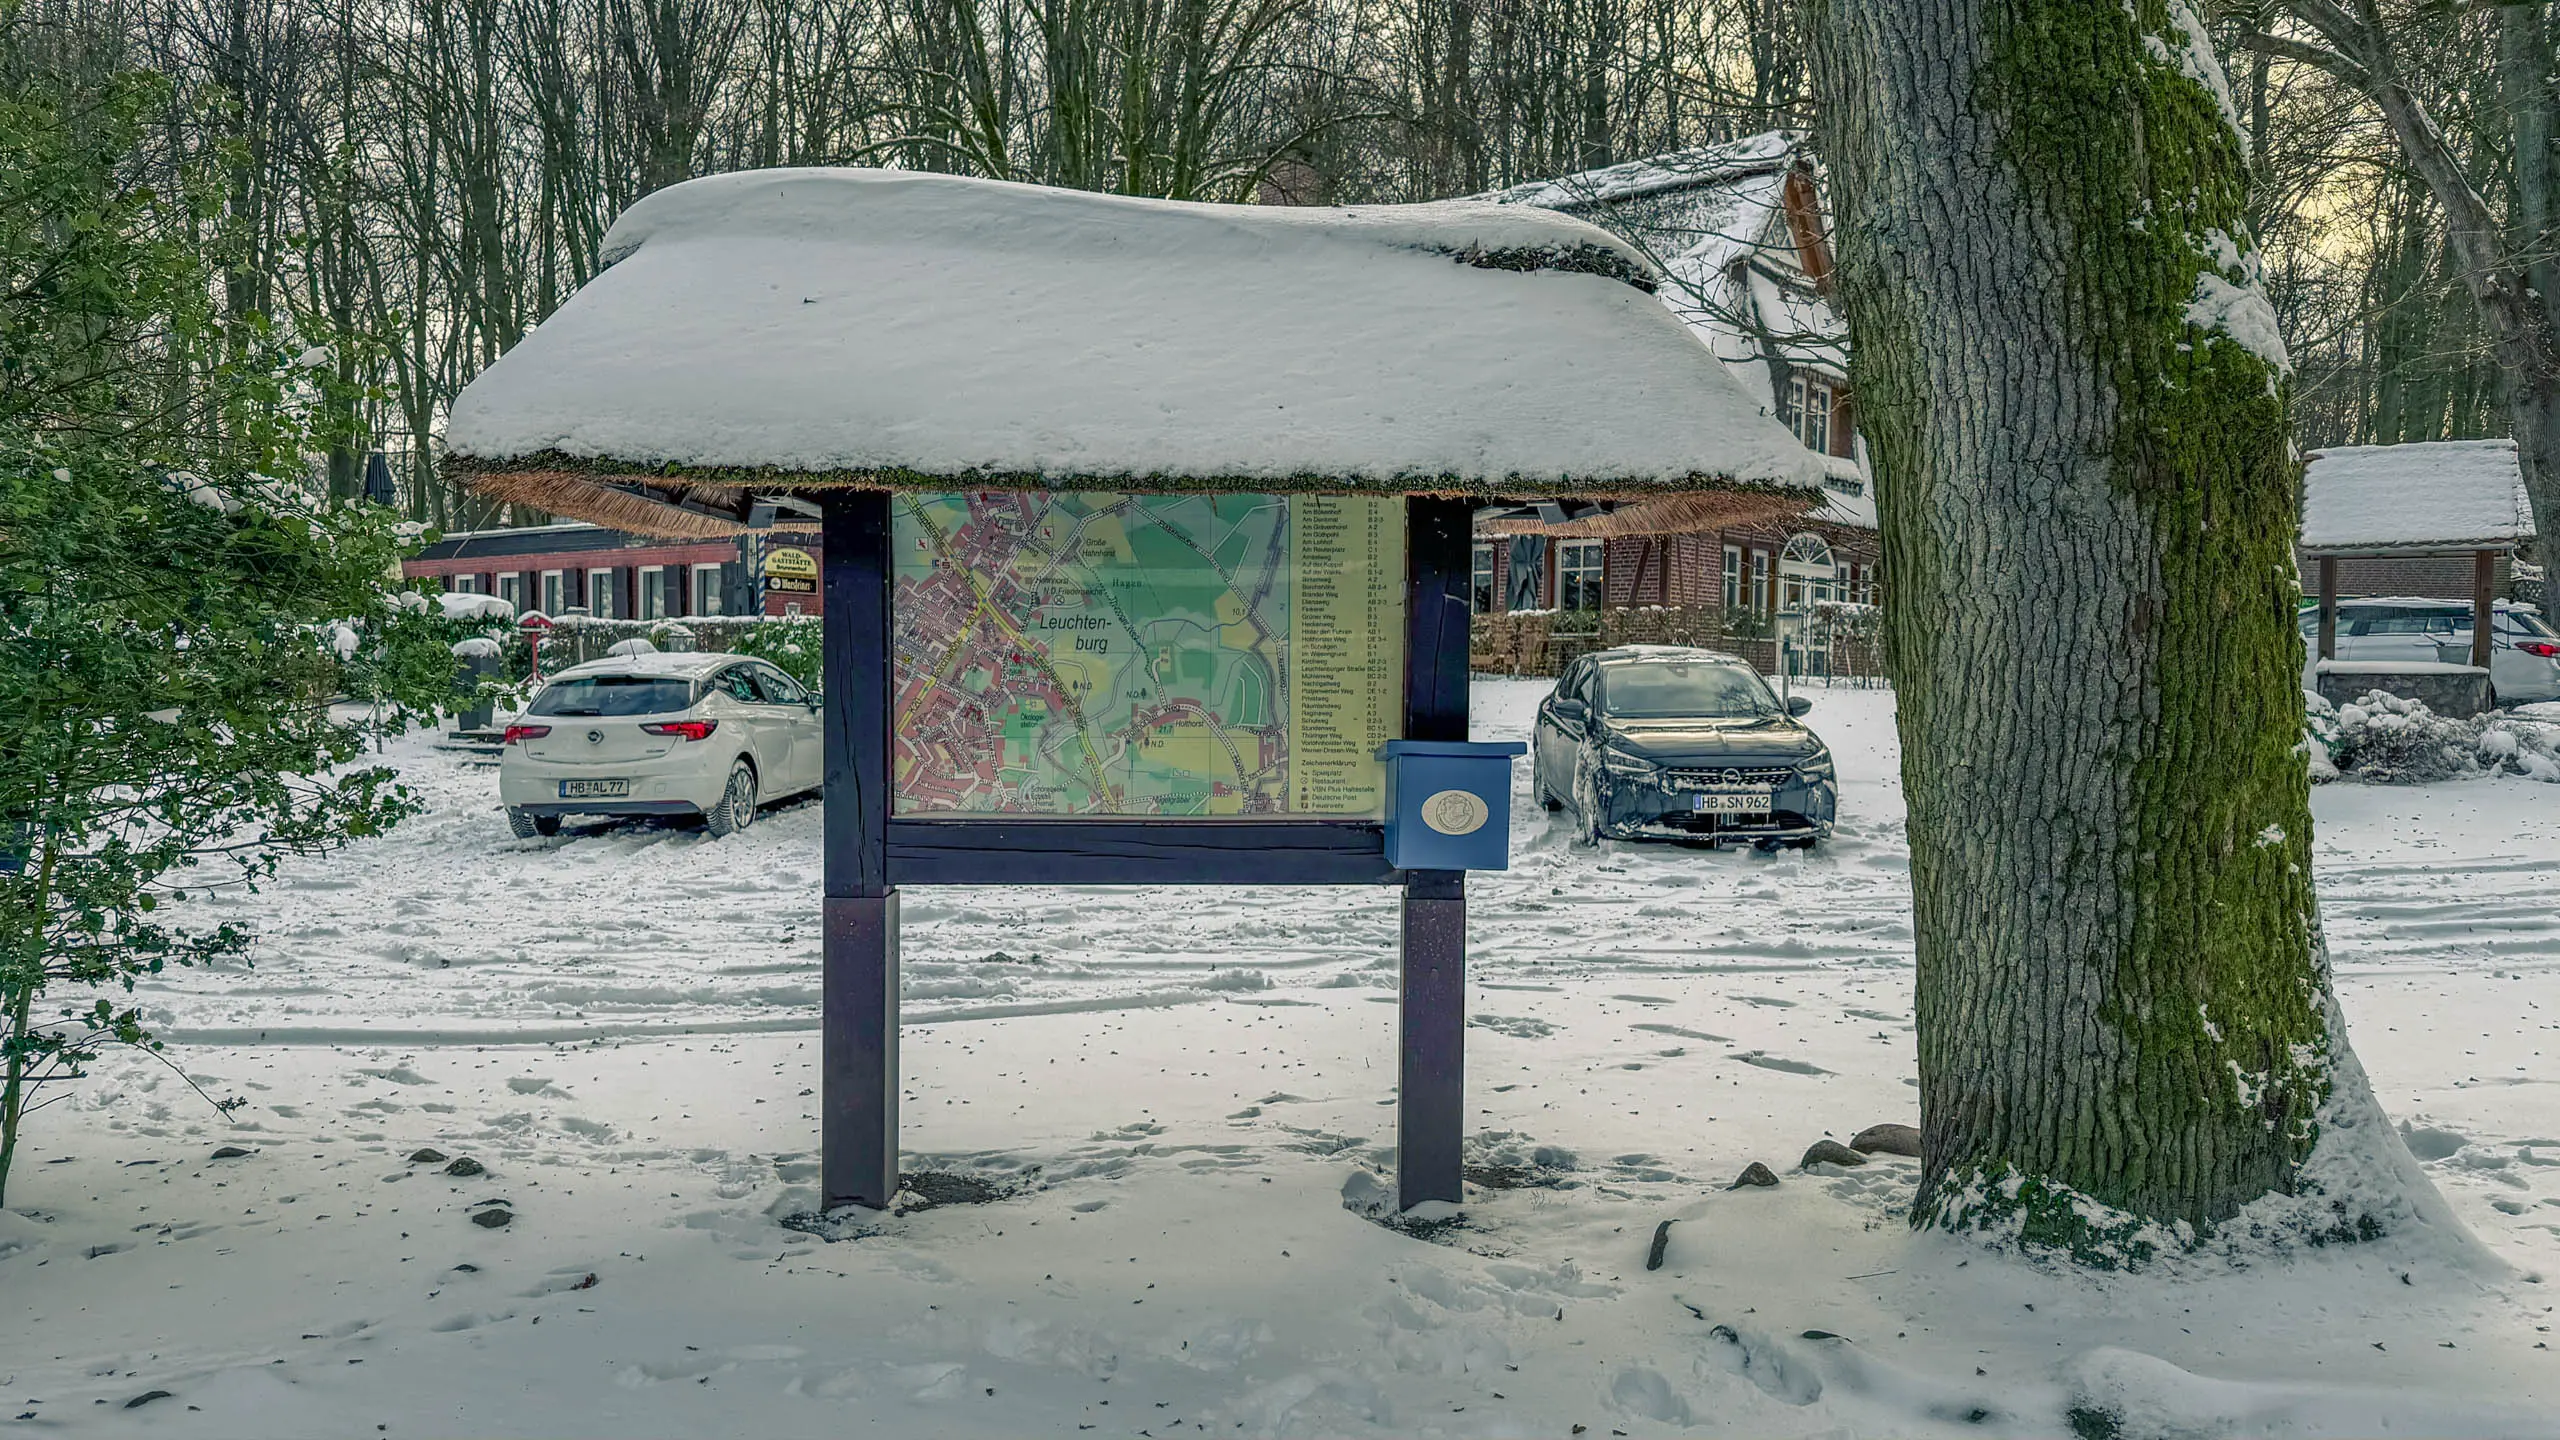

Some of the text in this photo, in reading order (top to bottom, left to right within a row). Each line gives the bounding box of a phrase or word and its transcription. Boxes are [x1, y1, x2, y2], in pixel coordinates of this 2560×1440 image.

[772, 557, 812, 566] GASTSTÄTTE
[1040, 614, 1112, 630] Leuchten-
[1076, 636, 1108, 654] burg
[570, 781, 623, 793] HB AL 77
[1702, 797, 1769, 808] HB SN 962
